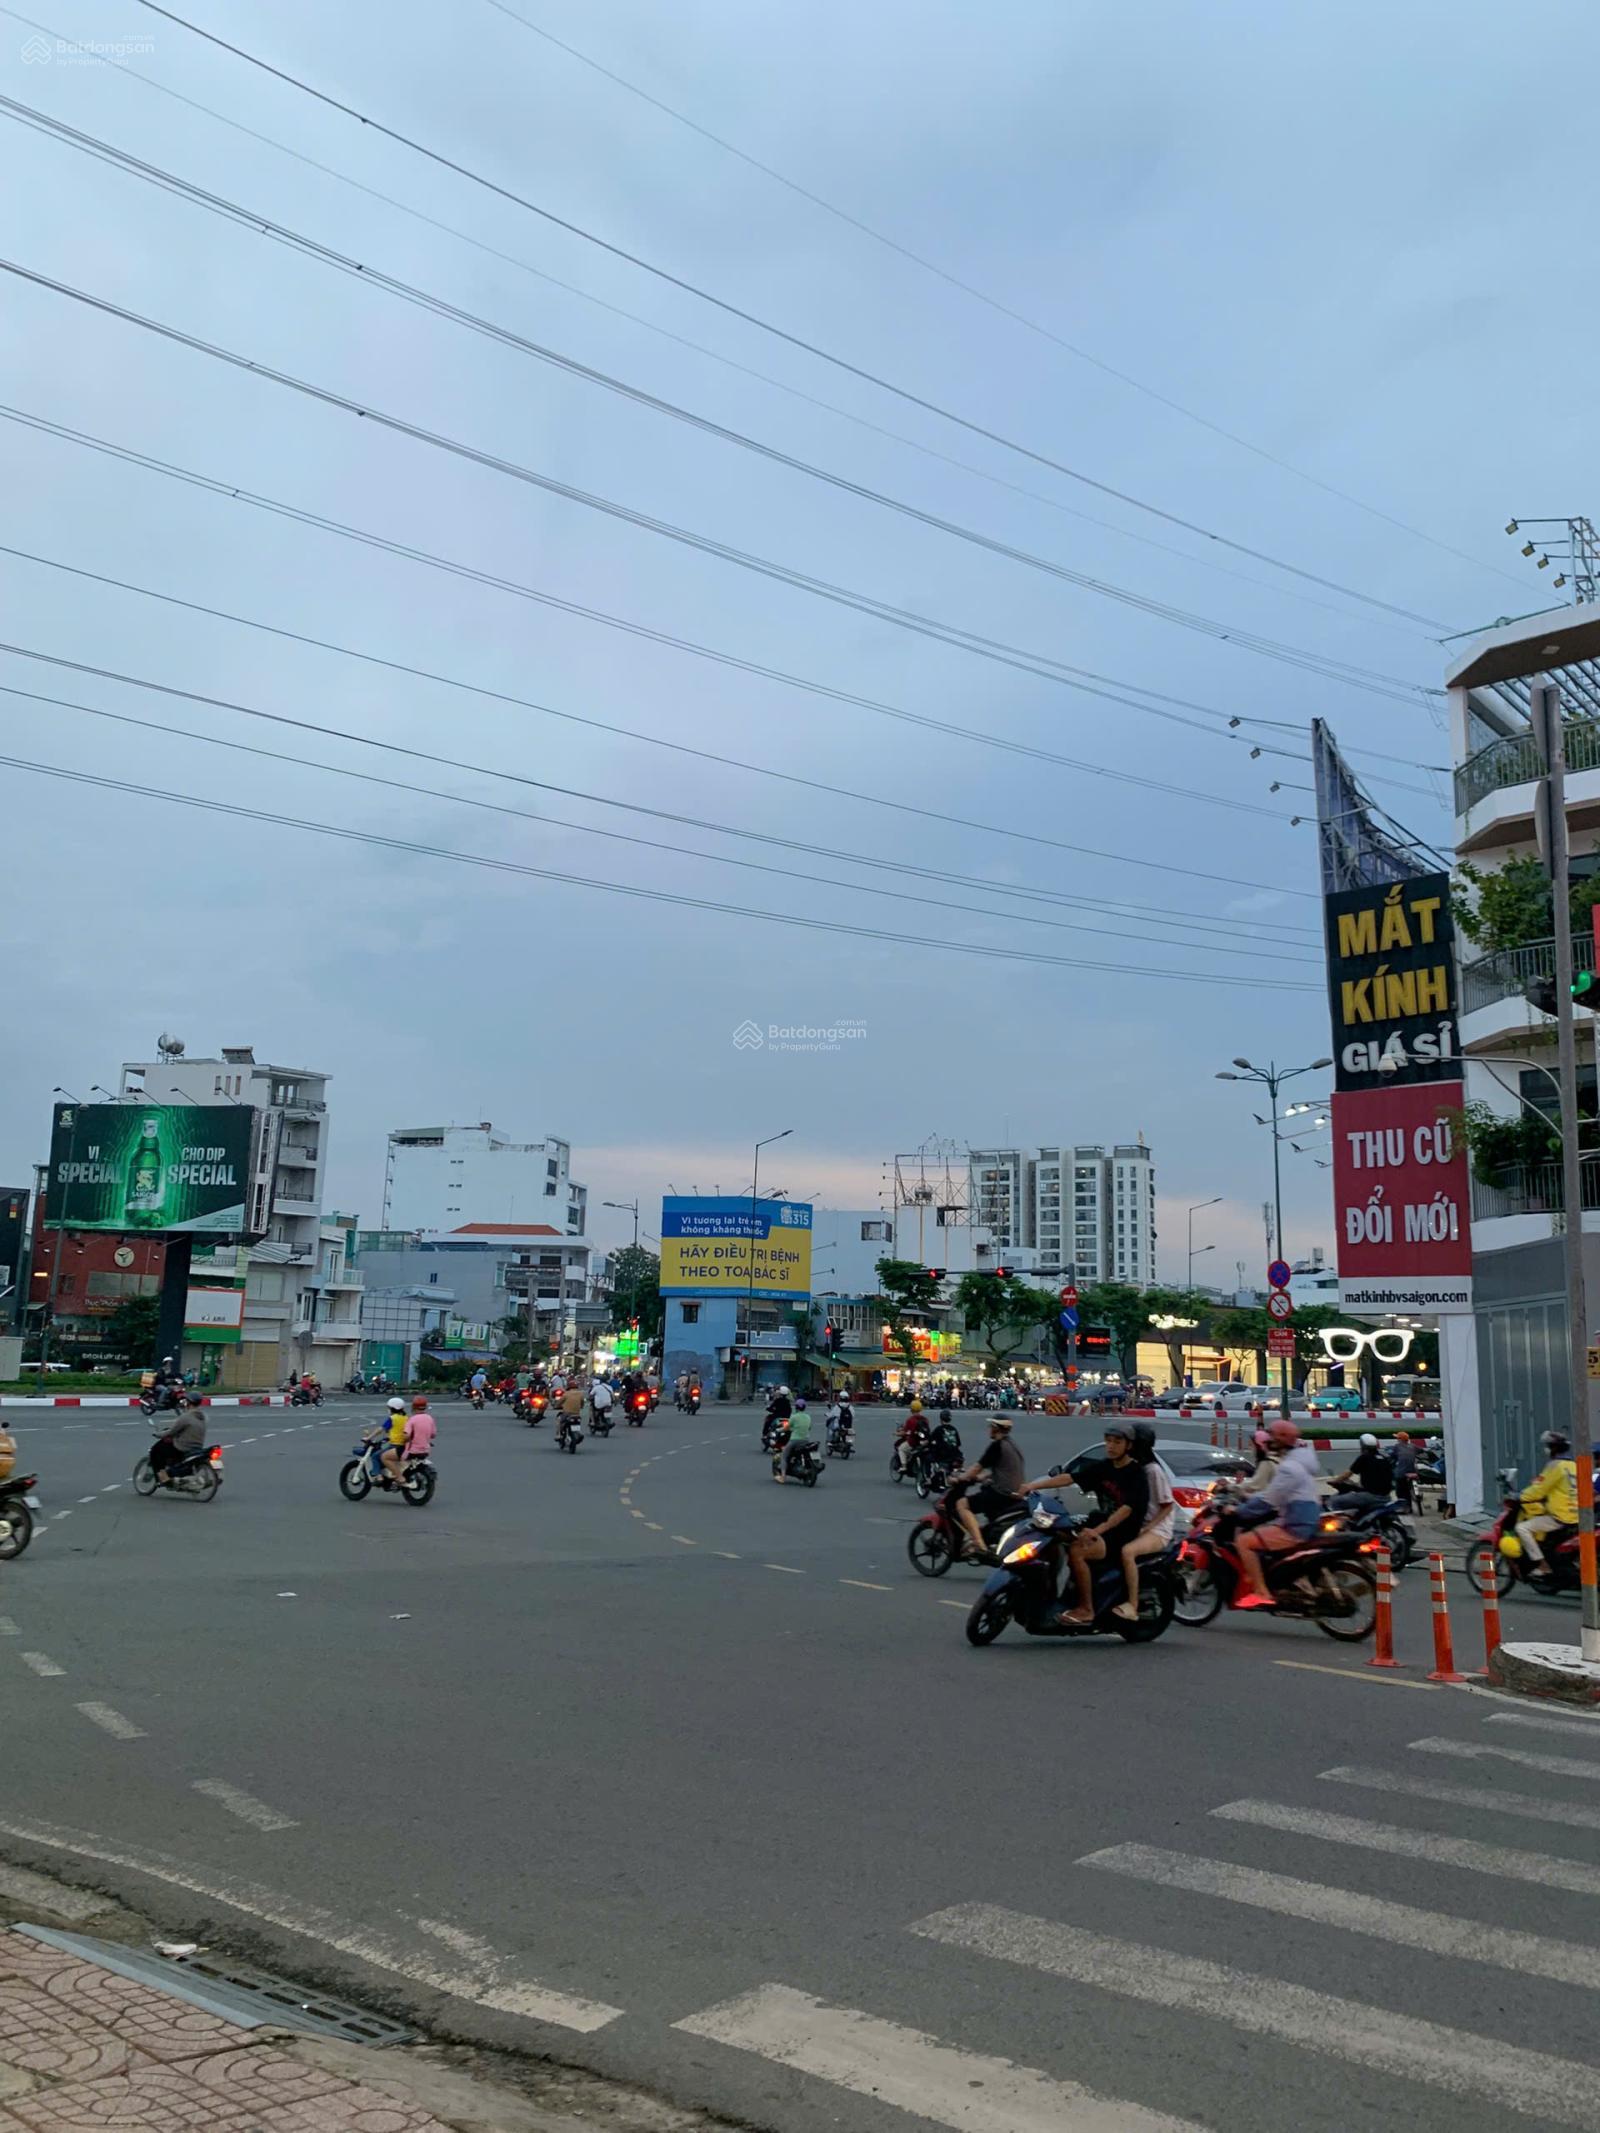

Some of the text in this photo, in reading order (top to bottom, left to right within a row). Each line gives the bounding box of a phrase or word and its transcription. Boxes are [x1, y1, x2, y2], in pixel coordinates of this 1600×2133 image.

[1338, 884, 1440, 958] MẮT
[1341, 964, 1448, 1025] KÍNH
[1342, 1020, 1453, 1073] GIÁ SỈ
[88, 1145, 100, 1162] VỊ
[1347, 1117, 1453, 1169] THU CŨ
[182, 1147, 226, 1163] CHO DỊP
[57, 1162, 123, 1184] SPECIAL
[167, 1164, 237, 1186] SPECIAL
[793, 1214, 809, 1226] 315
[1346, 1185, 1459, 1244] ĐỔI MỚI
[681, 1226, 710, 1235] không
[713, 1226, 741, 1235] kháng
[680, 1242, 800, 1265] HÃY ĐIỀU TRỊ BỆNH
[680, 1265, 720, 1277] THEO
[724, 1265, 751, 1277] TOA
[754, 1264, 776, 1280] BÁC
[1345, 1289, 1468, 1306] matkinhbvsaigon.com
